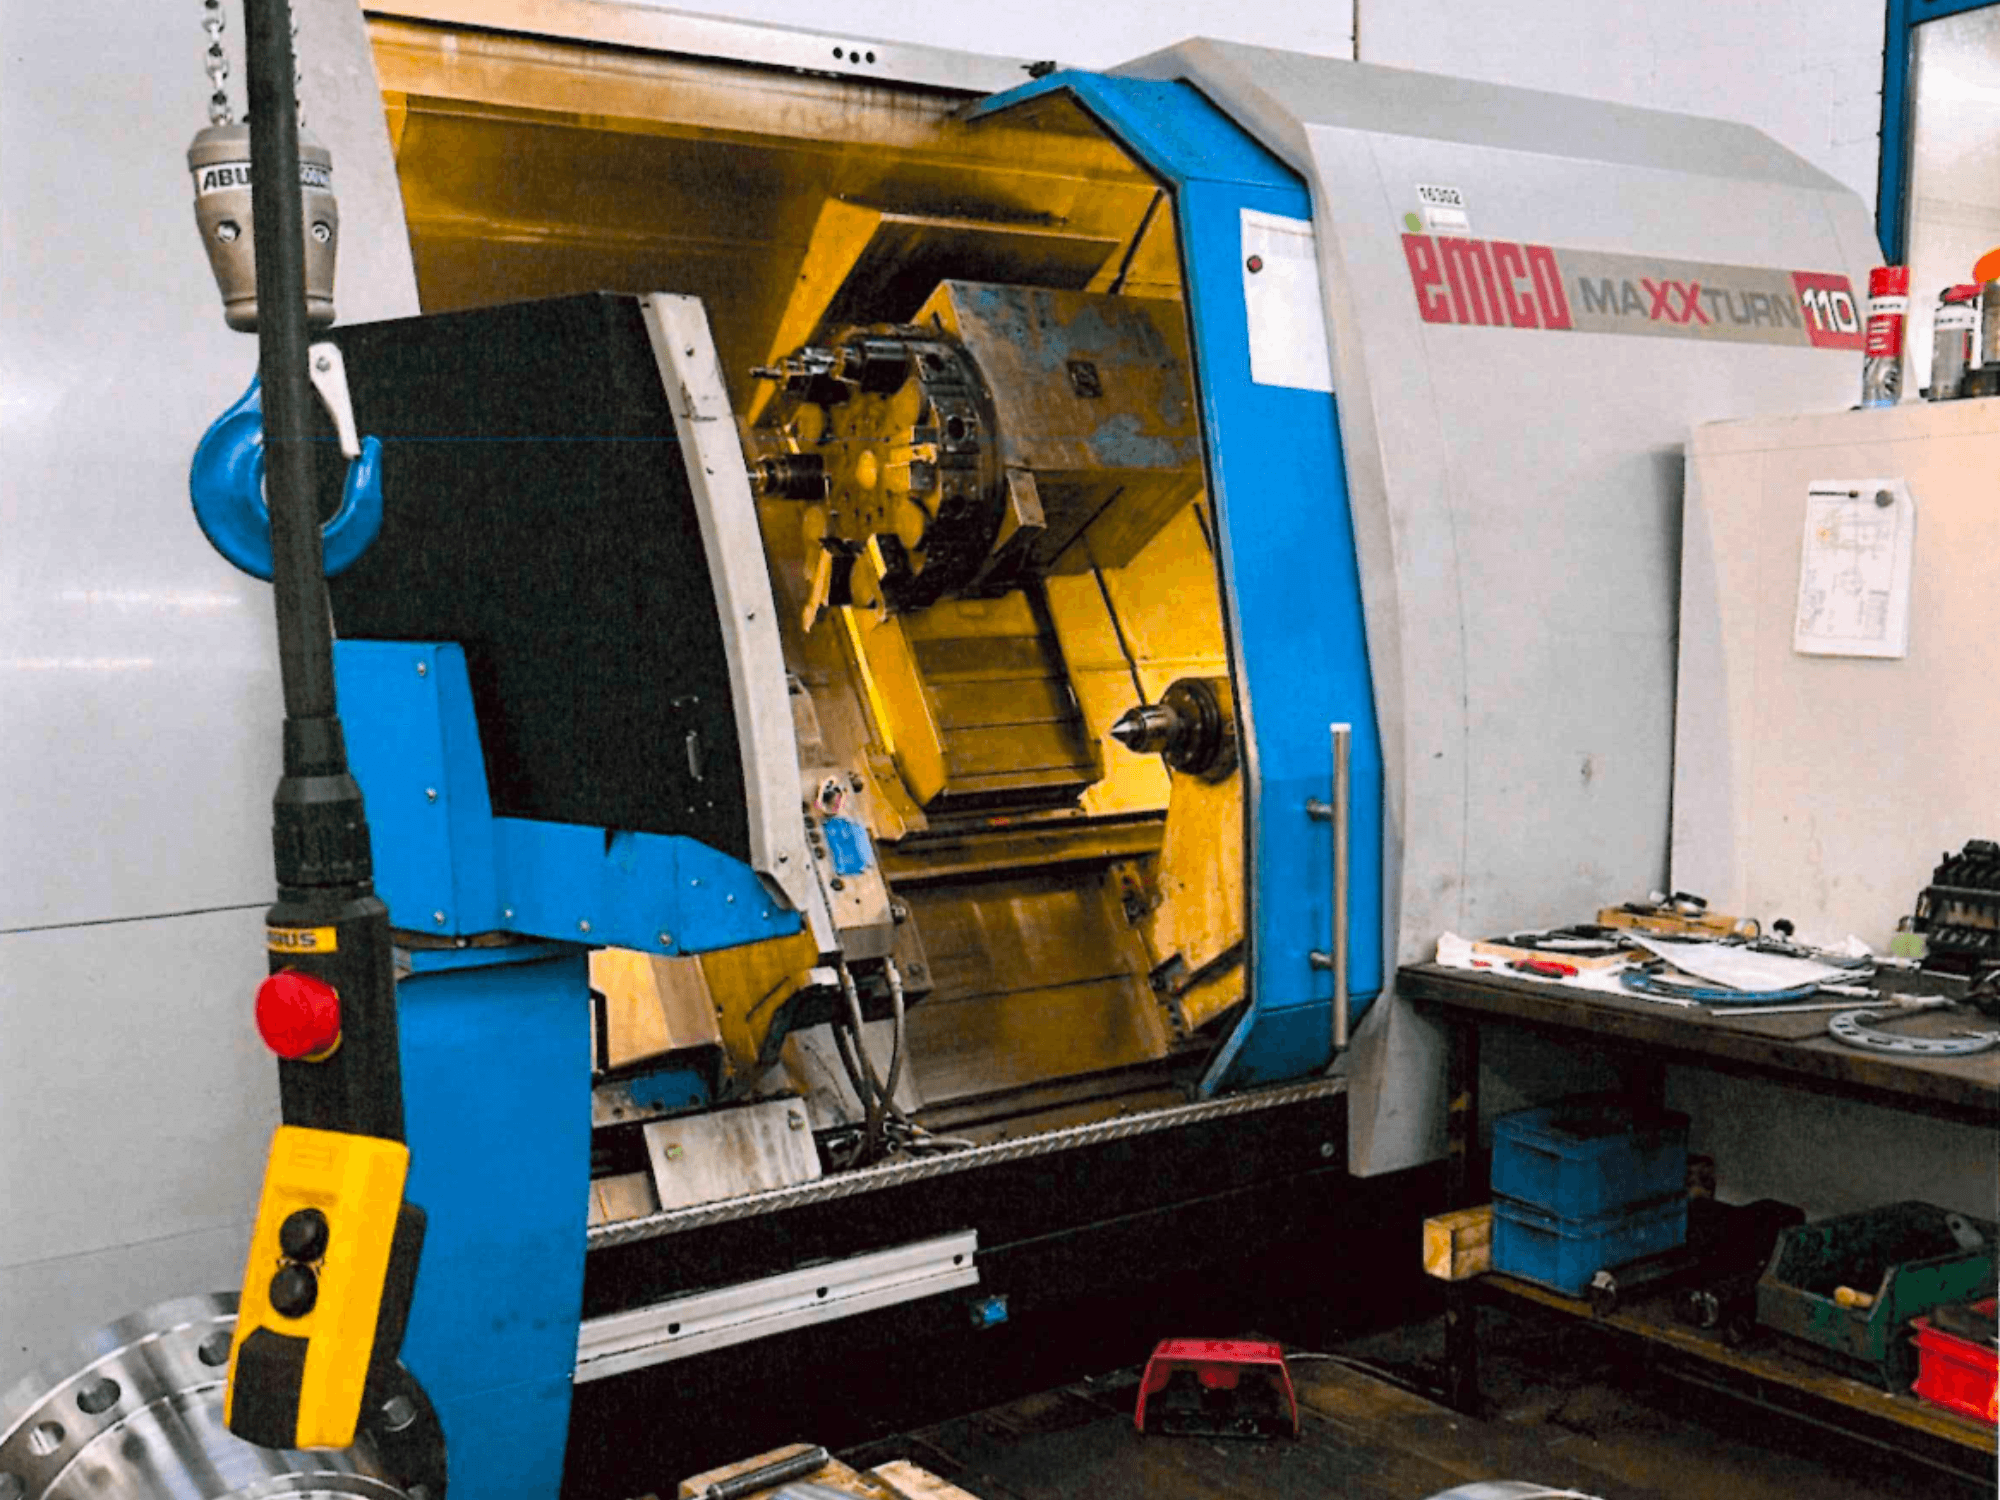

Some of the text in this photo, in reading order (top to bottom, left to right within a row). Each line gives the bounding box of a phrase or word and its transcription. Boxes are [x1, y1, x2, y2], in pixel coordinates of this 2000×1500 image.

[204, 166, 252, 191] ABU
[1578, 277, 1861, 333] MAXXTURN 110
